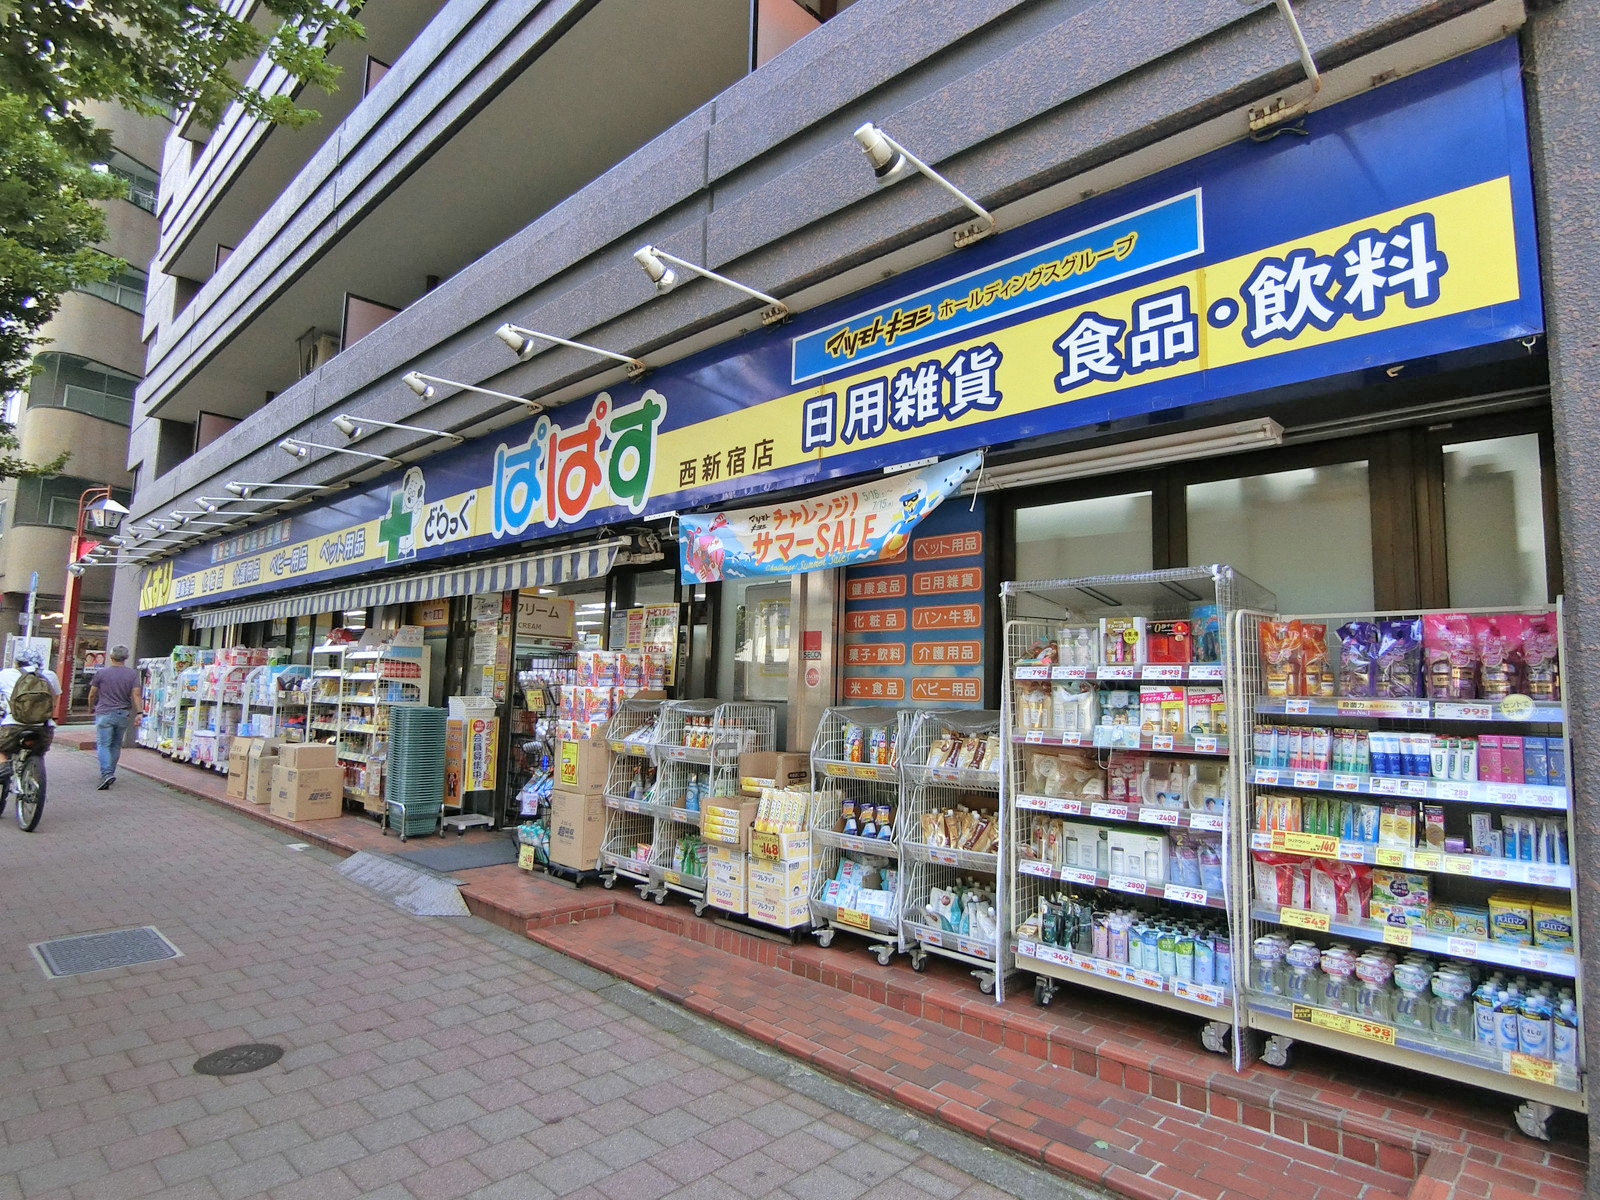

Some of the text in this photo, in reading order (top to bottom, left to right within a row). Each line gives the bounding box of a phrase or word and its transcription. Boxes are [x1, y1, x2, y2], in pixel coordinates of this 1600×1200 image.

[825, 230, 1139, 359] マツモトキヨシ ホールディングスグループ
[802, 216, 1444, 449] 日用雑貨 食品・飲料
[494, 393, 664, 535] ぱぱす
[679, 439, 775, 488] 西新宿店
[424, 492, 476, 543] どらっぐ
[319, 528, 366, 563] ペット用品
[916, 535, 978, 557] ペット用品
[851, 578, 901, 596] 健康食品
[919, 572, 974, 591] 日用雑貨
[853, 612, 898, 628] 化粧品
[917, 608, 977, 625] パン・牛乳
[518, 622, 542, 630] CREAM
[848, 647, 901, 661] 菓子・飲料
[918, 645, 974, 661] 介護用品
[850, 681, 898, 696] 米・食品
[915, 681, 977, 697] ベビー用品
[1463, 707, 1490, 716] 998
[1184, 891, 1204, 900] 739
[1303, 916, 1327, 926] 549
[1497, 915, 1525, 924] バスロマン
[1540, 922, 1568, 931] バスロマン
[1363, 1024, 1391, 1037] 598
